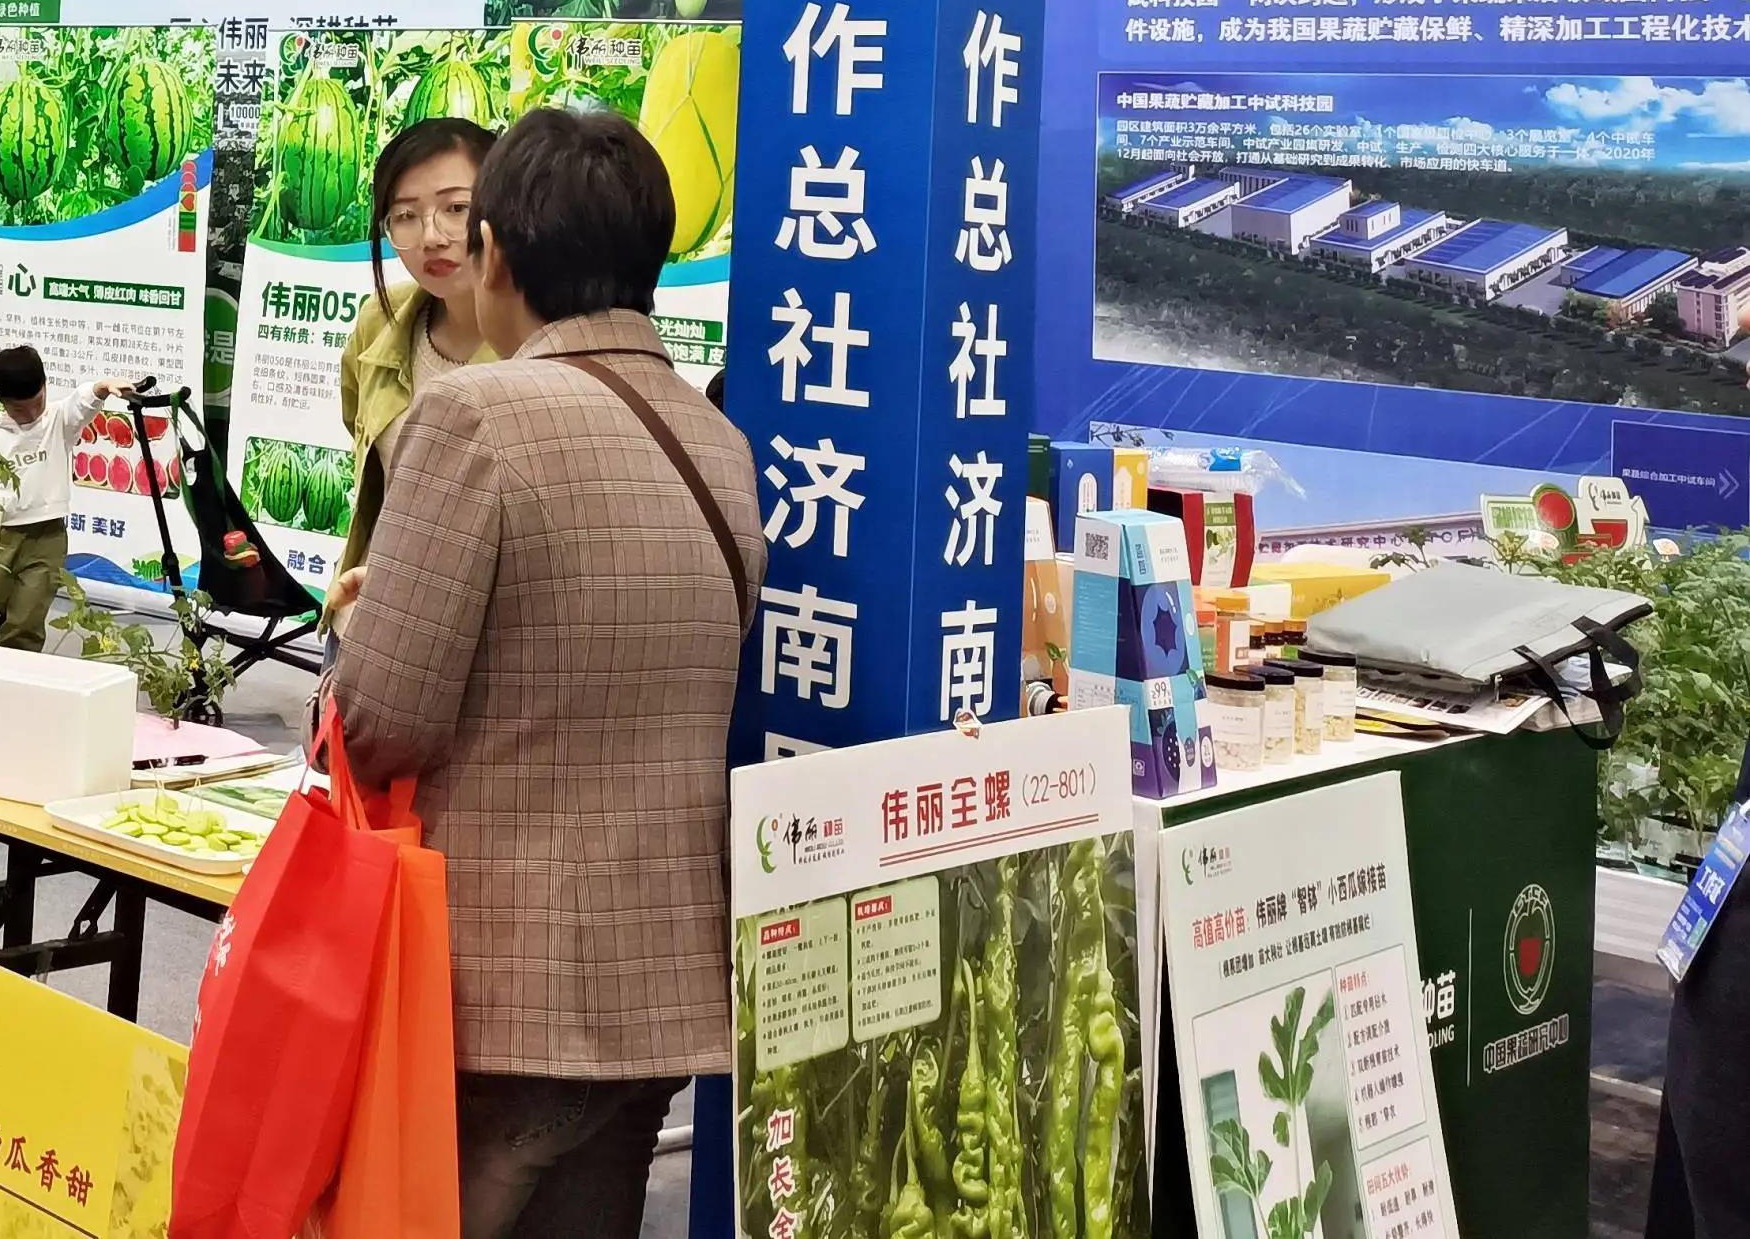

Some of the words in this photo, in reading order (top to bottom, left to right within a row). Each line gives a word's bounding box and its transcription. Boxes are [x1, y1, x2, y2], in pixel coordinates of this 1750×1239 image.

[216, 59, 266, 94] 未来
[287, 549, 326, 575] 融合
[881, 770, 1011, 844] 伟丽全螺
